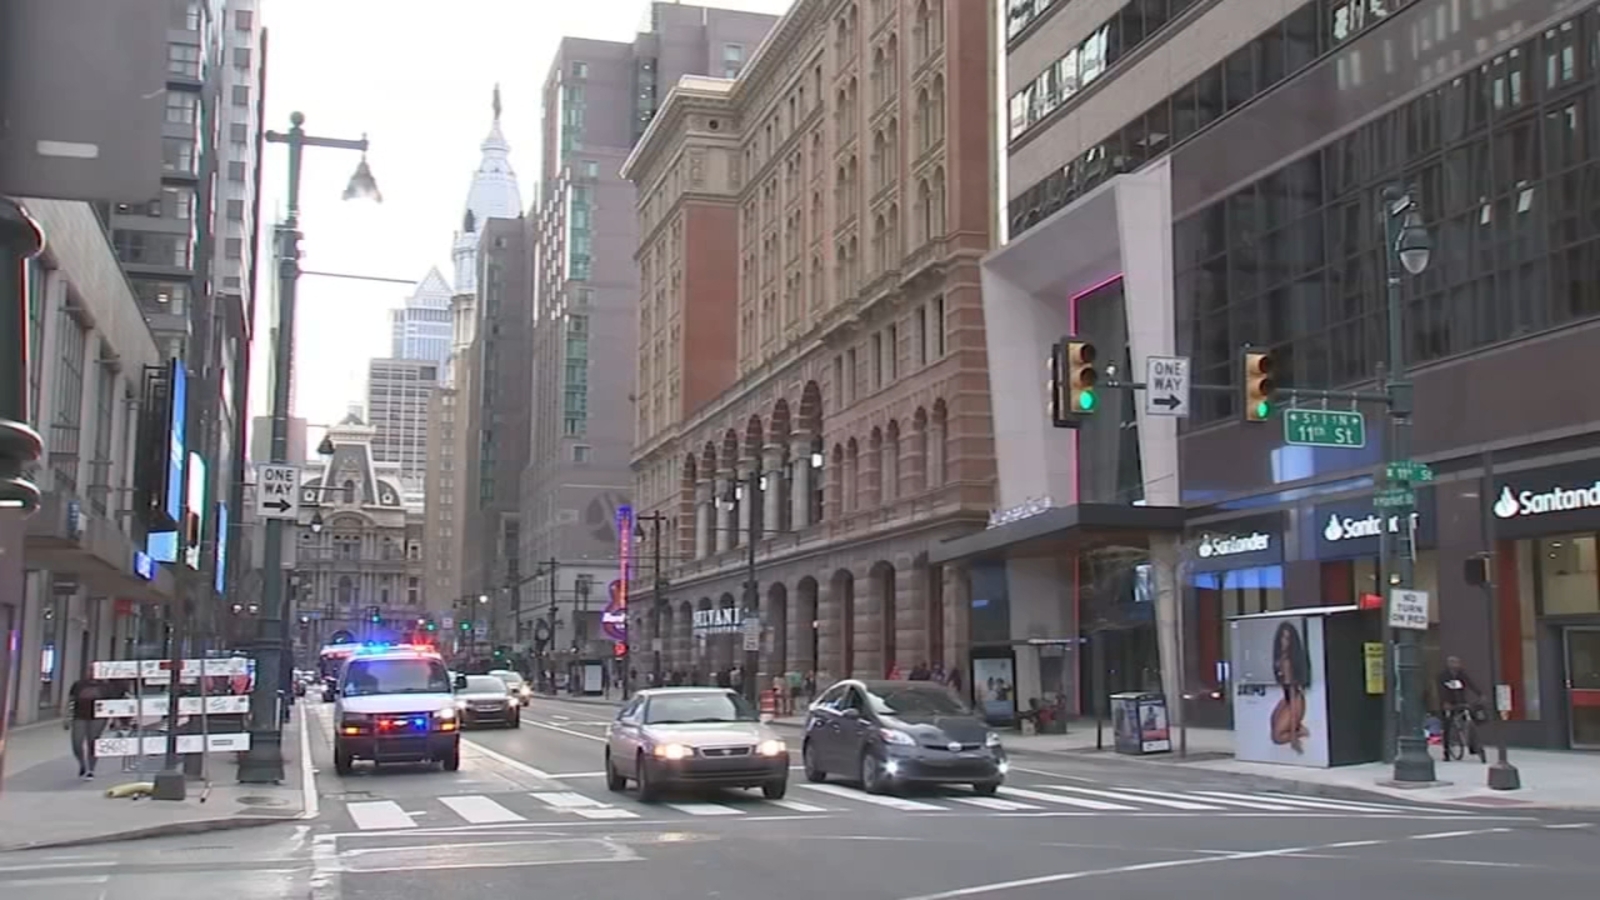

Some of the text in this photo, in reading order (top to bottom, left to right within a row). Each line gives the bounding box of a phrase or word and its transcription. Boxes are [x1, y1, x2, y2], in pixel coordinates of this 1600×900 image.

[1154, 361, 1181, 376] ONE
[1153, 377, 1182, 390] WAY
[1298, 426, 1354, 443] 11th St
[264, 468, 294, 482] ONE
[264, 482, 293, 495] WAY
[1212, 532, 1270, 556] Santander
[1403, 594, 1416, 603] NO
[1397, 603, 1423, 613] TURN
[1393, 613, 1426, 625] ON RED
